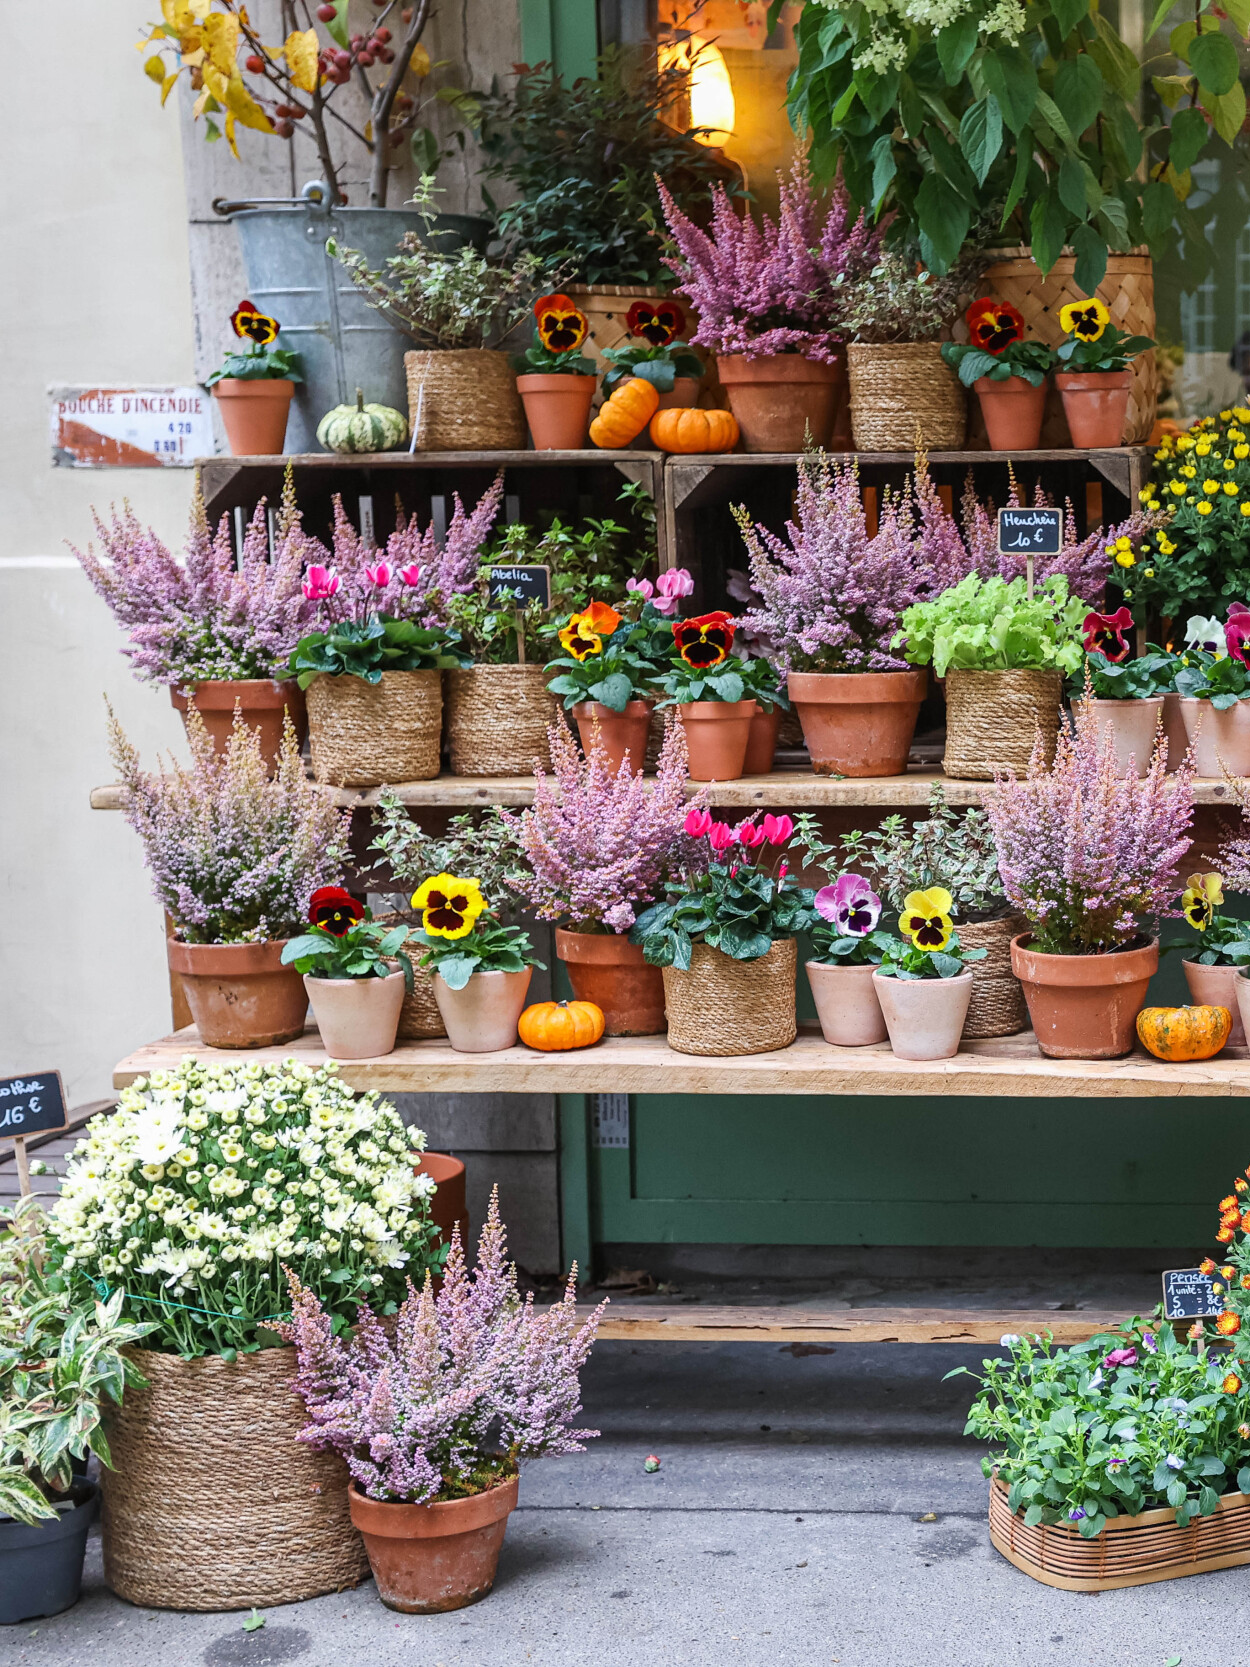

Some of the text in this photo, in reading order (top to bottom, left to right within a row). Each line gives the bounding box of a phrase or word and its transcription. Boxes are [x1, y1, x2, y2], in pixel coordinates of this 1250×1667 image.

[58, 397, 203, 415] BOUCHE D'INCENDIE
[491, 568, 533, 581] Abelia
